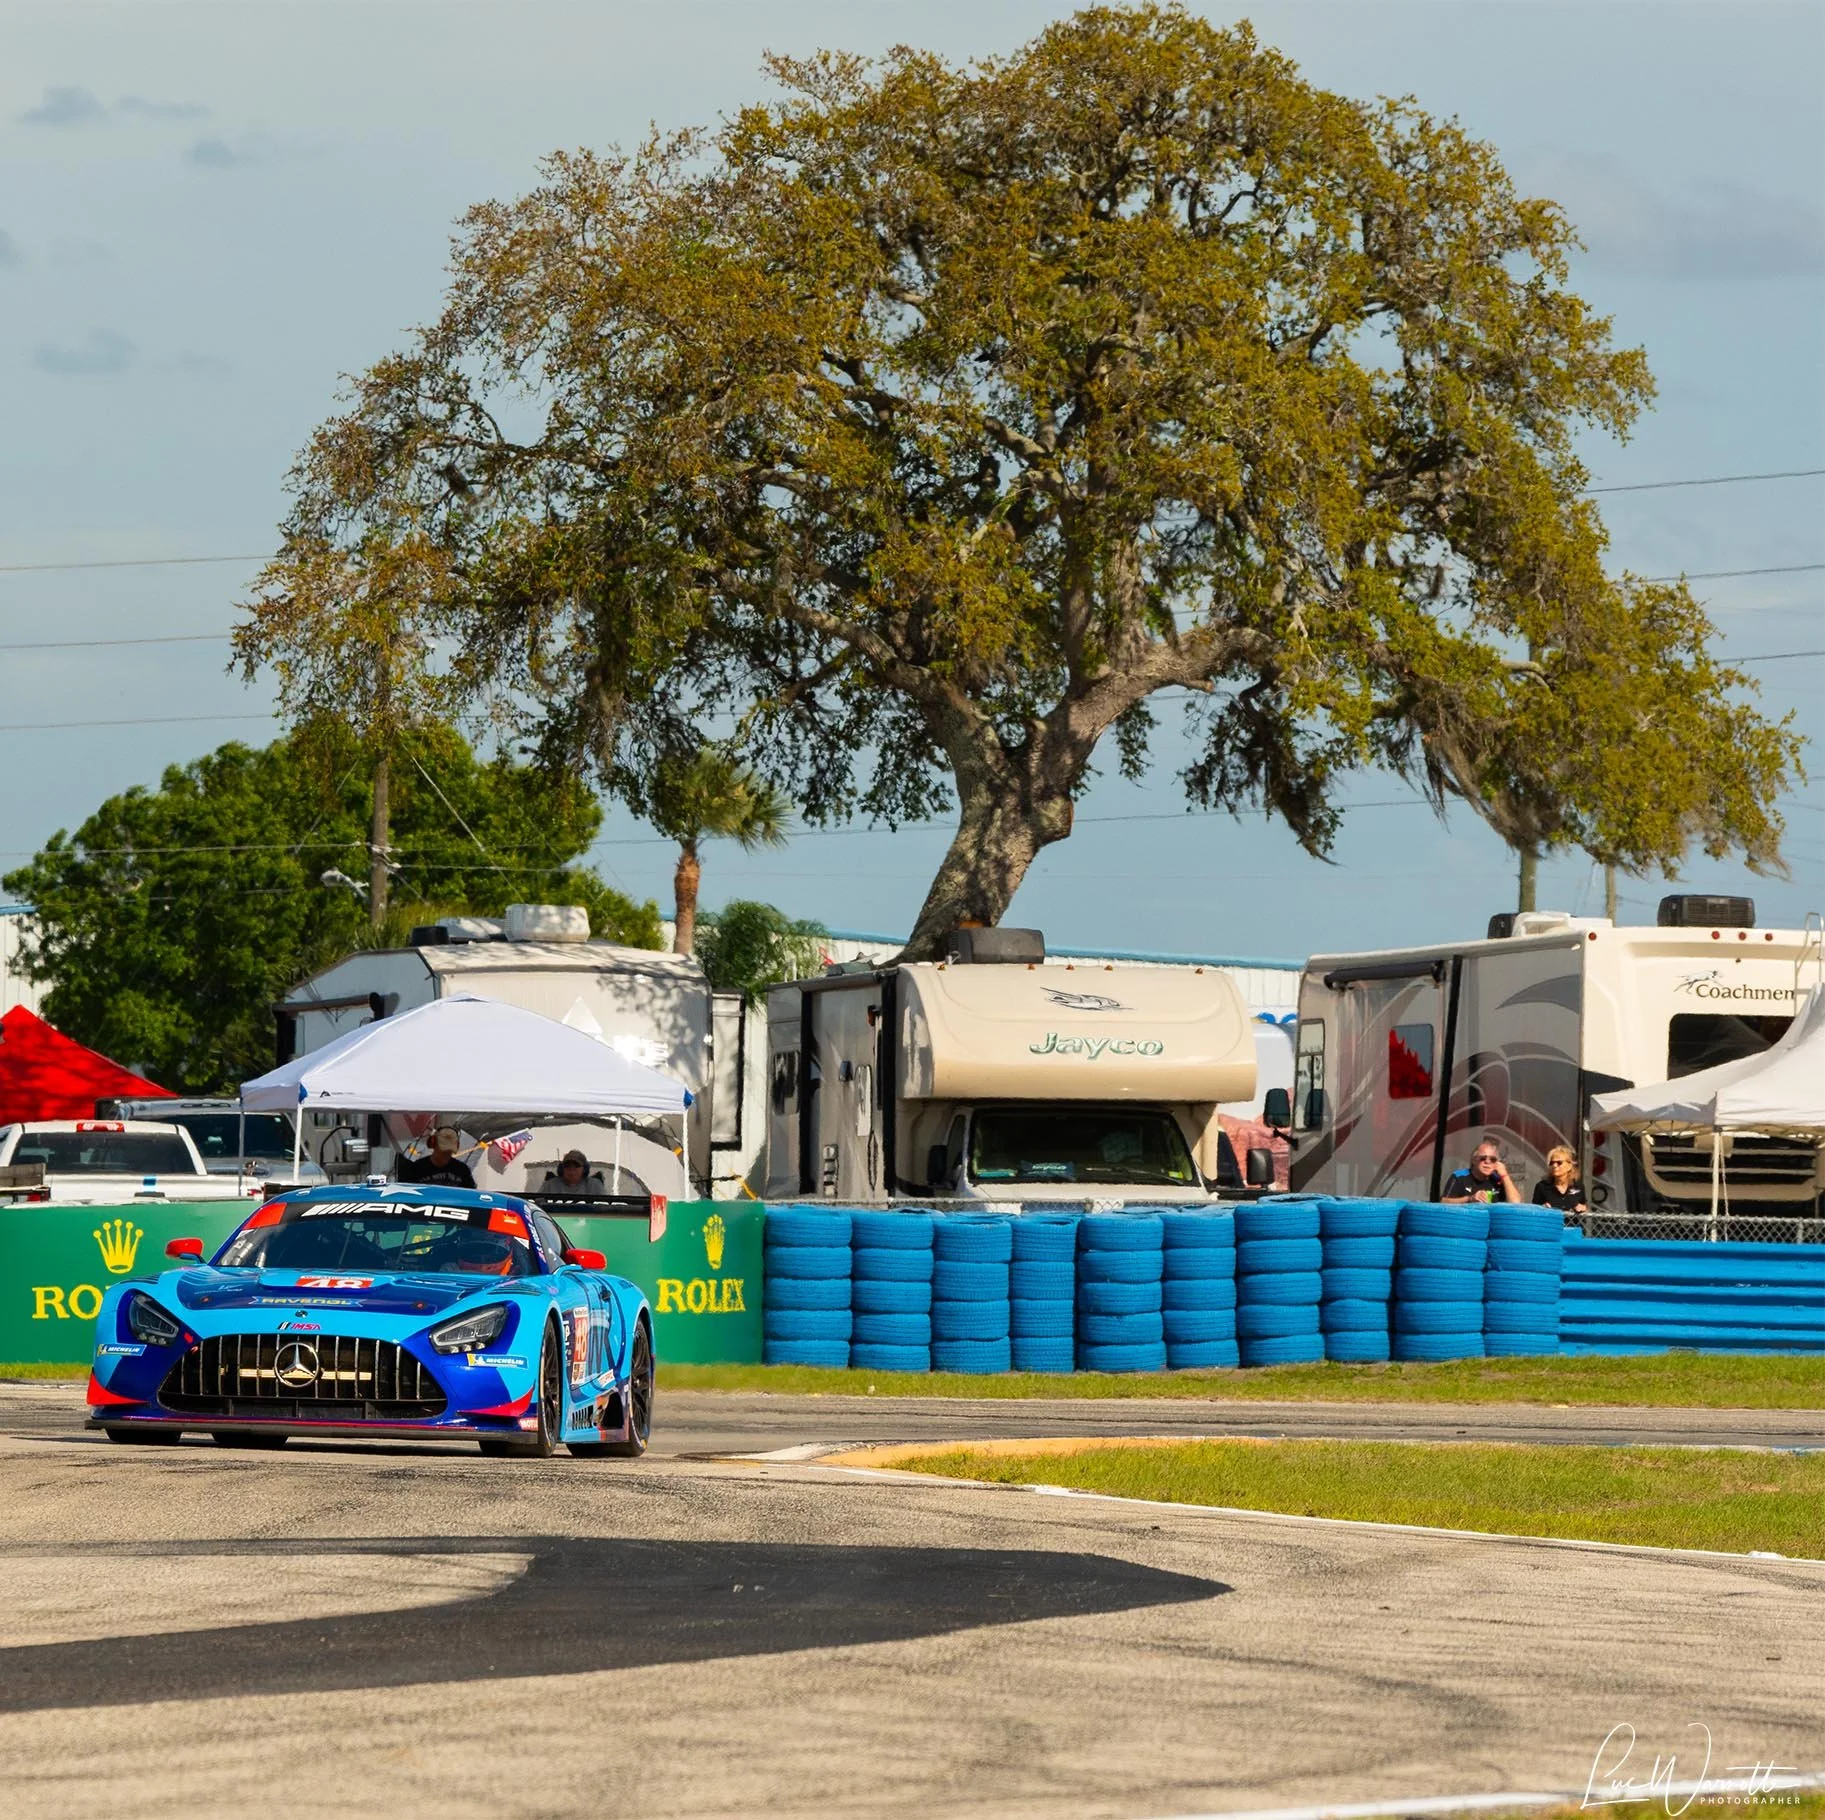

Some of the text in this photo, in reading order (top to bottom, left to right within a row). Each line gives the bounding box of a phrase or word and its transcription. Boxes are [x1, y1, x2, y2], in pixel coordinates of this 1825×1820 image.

[1695, 984, 1795, 1000] Coachmen
[1029, 1032, 1164, 1060] Jayco
[354, 1202, 470, 1221] AMG
[299, 1278, 364, 1289] 48
[31, 1283, 104, 1320] RO
[655, 1278, 746, 1314] ROLEX
[291, 1322, 321, 1331] IMSA
[107, 1345, 141, 1353] MICHELIN
[485, 1357, 524, 1366] MICHELIN
